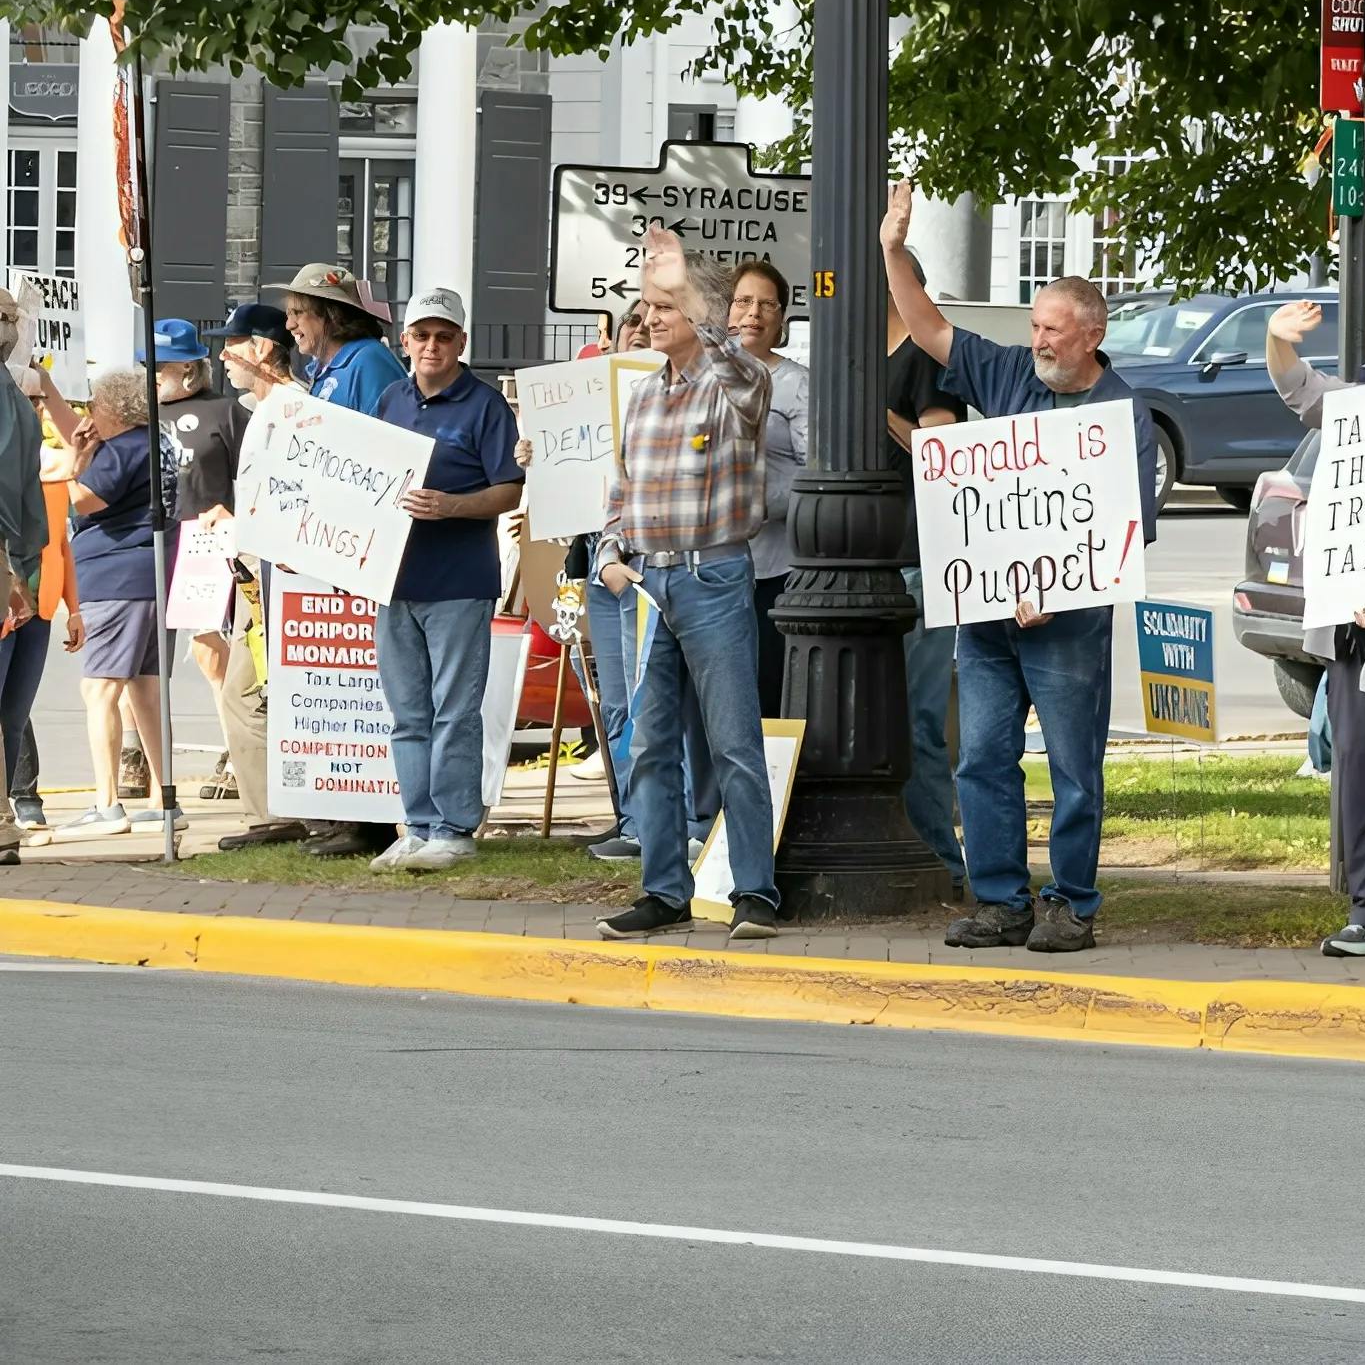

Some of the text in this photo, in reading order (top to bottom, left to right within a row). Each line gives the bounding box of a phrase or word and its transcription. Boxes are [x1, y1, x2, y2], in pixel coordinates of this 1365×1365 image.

[594, 182, 809, 213] 39 SYRACUSE
[701, 218, 778, 243] UTICA
[591, 277, 608, 299] 5
[813, 271, 836, 299] 15
[34, 318, 71, 351] UMP
[529, 377, 603, 409] THIS IS
[920, 416, 1107, 488] Donald is
[952, 468, 1095, 548] Putin's
[301, 596, 345, 615] END
[1161, 641, 1195, 671] WITH
[304, 671, 332, 687] Tax
[291, 693, 384, 713] Companies
[294, 715, 348, 735] Higher
[280, 739, 388, 759] COMPETITION
[330, 761, 364, 774] NOT
